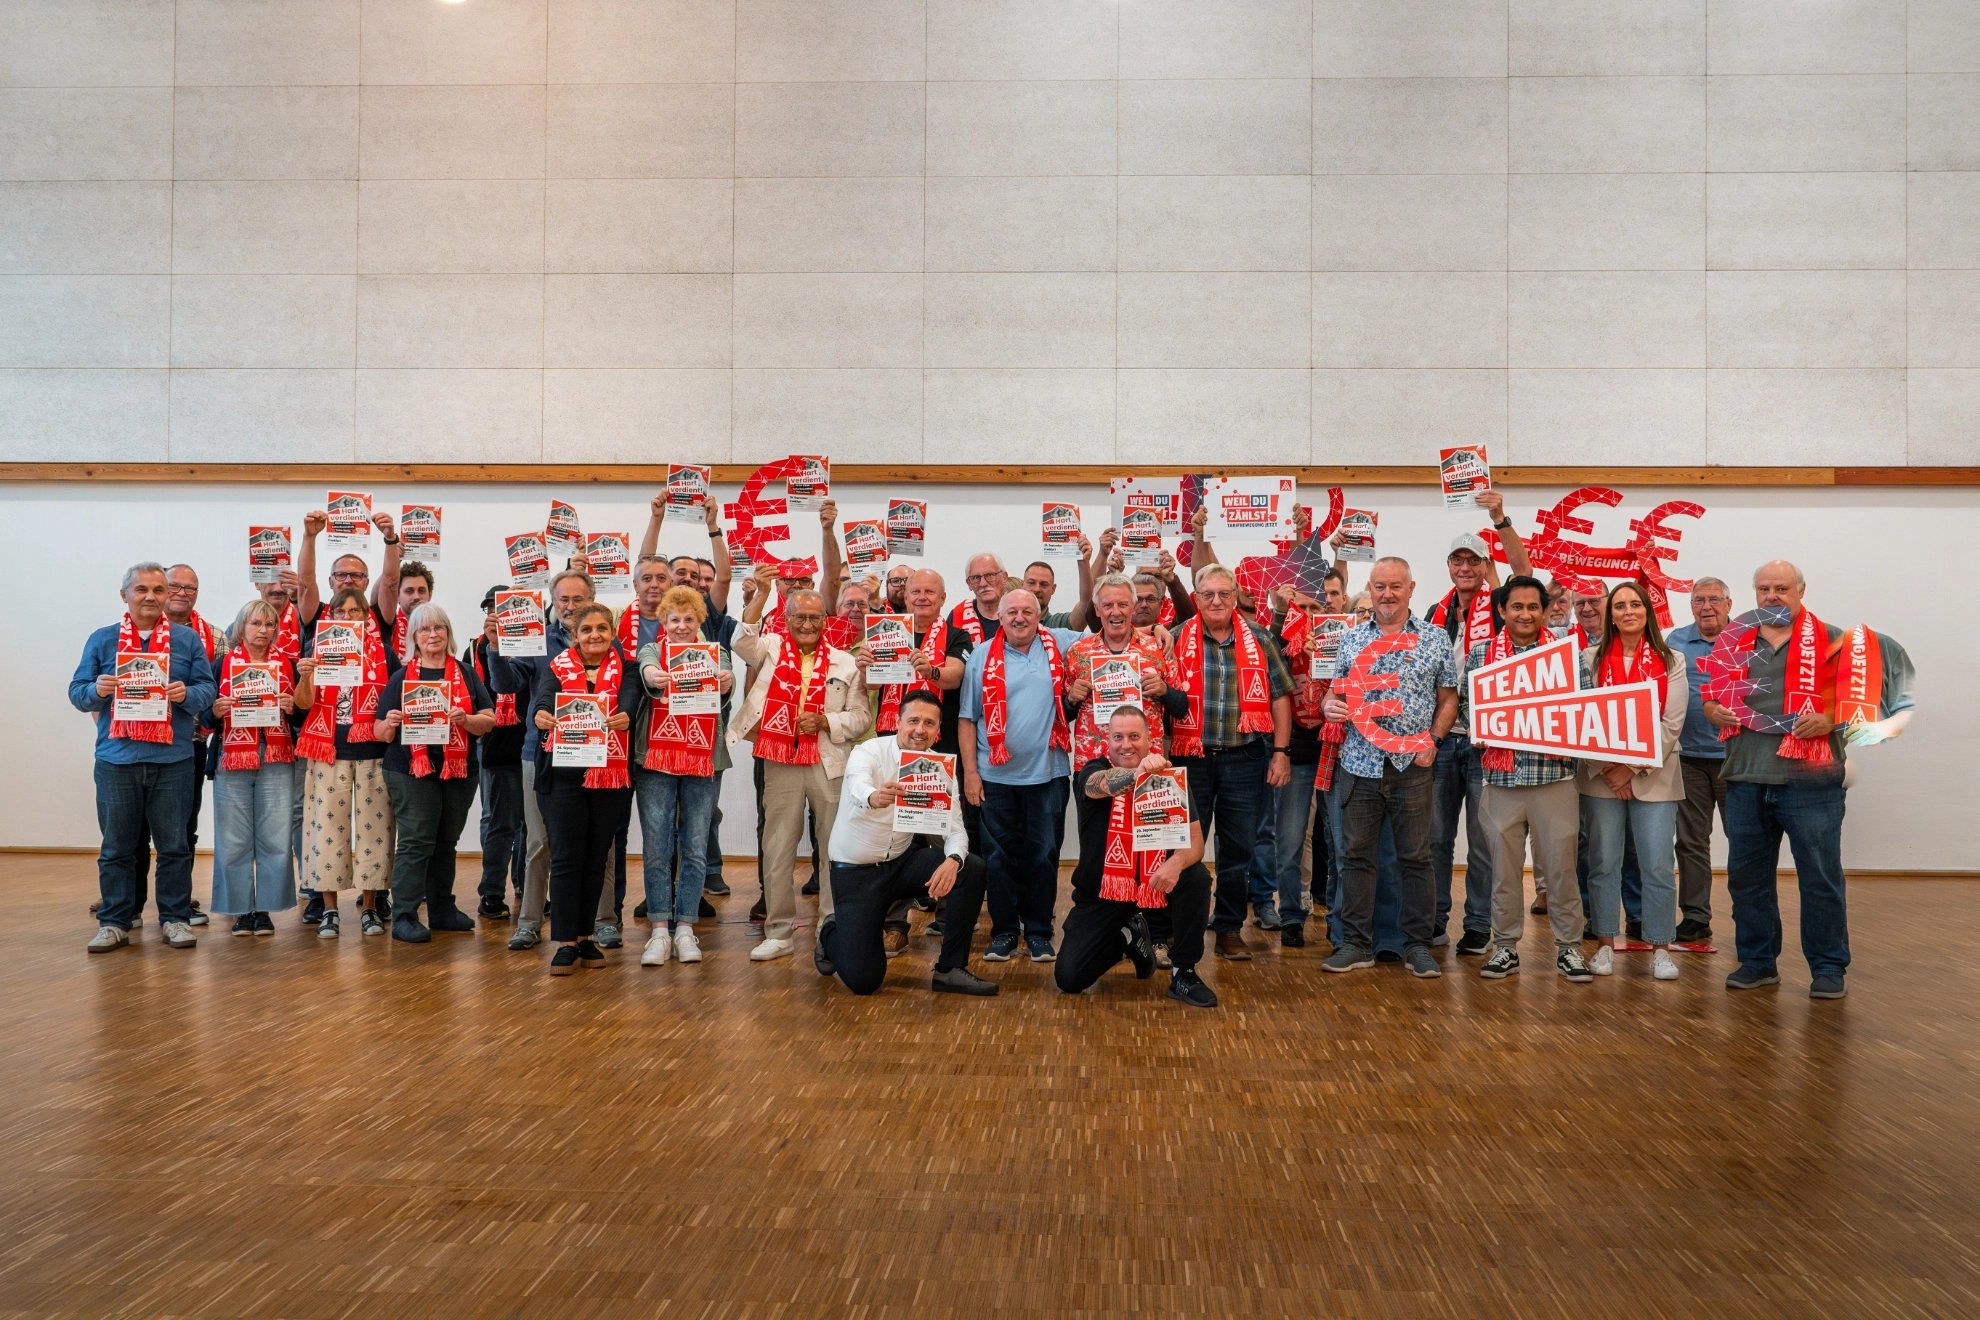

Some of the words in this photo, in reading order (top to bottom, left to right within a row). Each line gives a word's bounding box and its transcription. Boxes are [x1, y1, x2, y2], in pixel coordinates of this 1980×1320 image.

[1456, 461, 1474, 470] Hart
[1445, 468, 1482, 479] verdient!
[1130, 496, 1151, 505] WEIL
[1156, 496, 1168, 505] DU
[1224, 497, 1248, 507] WEIL
[1252, 496, 1266, 506] DU
[1228, 508, 1266, 521] ZÄHLST
[859, 534, 874, 542] Hart
[520, 546, 535, 555] Hart
[849, 541, 881, 551] verdient!
[512, 552, 542, 563] verdient!
[511, 607, 529, 615] Hart
[500, 614, 537, 623] verdient!
[1326, 631, 1342, 639] Hart
[870, 639, 906, 648] verdient!
[686, 661, 704, 670] Hart
[1799, 642, 1815, 691] JETZT!
[673, 669, 712, 678] verdient!
[1108, 672, 1125, 680] Hart
[1478, 652, 1568, 700] TEAM
[1851, 652, 1866, 700] JETZT!
[1096, 679, 1133, 688] verdient!
[235, 686, 272, 694] verdient!
[1480, 711, 1508, 737] IG
[1513, 698, 1647, 752] METALL
[1150, 789, 1170, 799] Hart
[1137, 797, 1179, 809] verdient!
